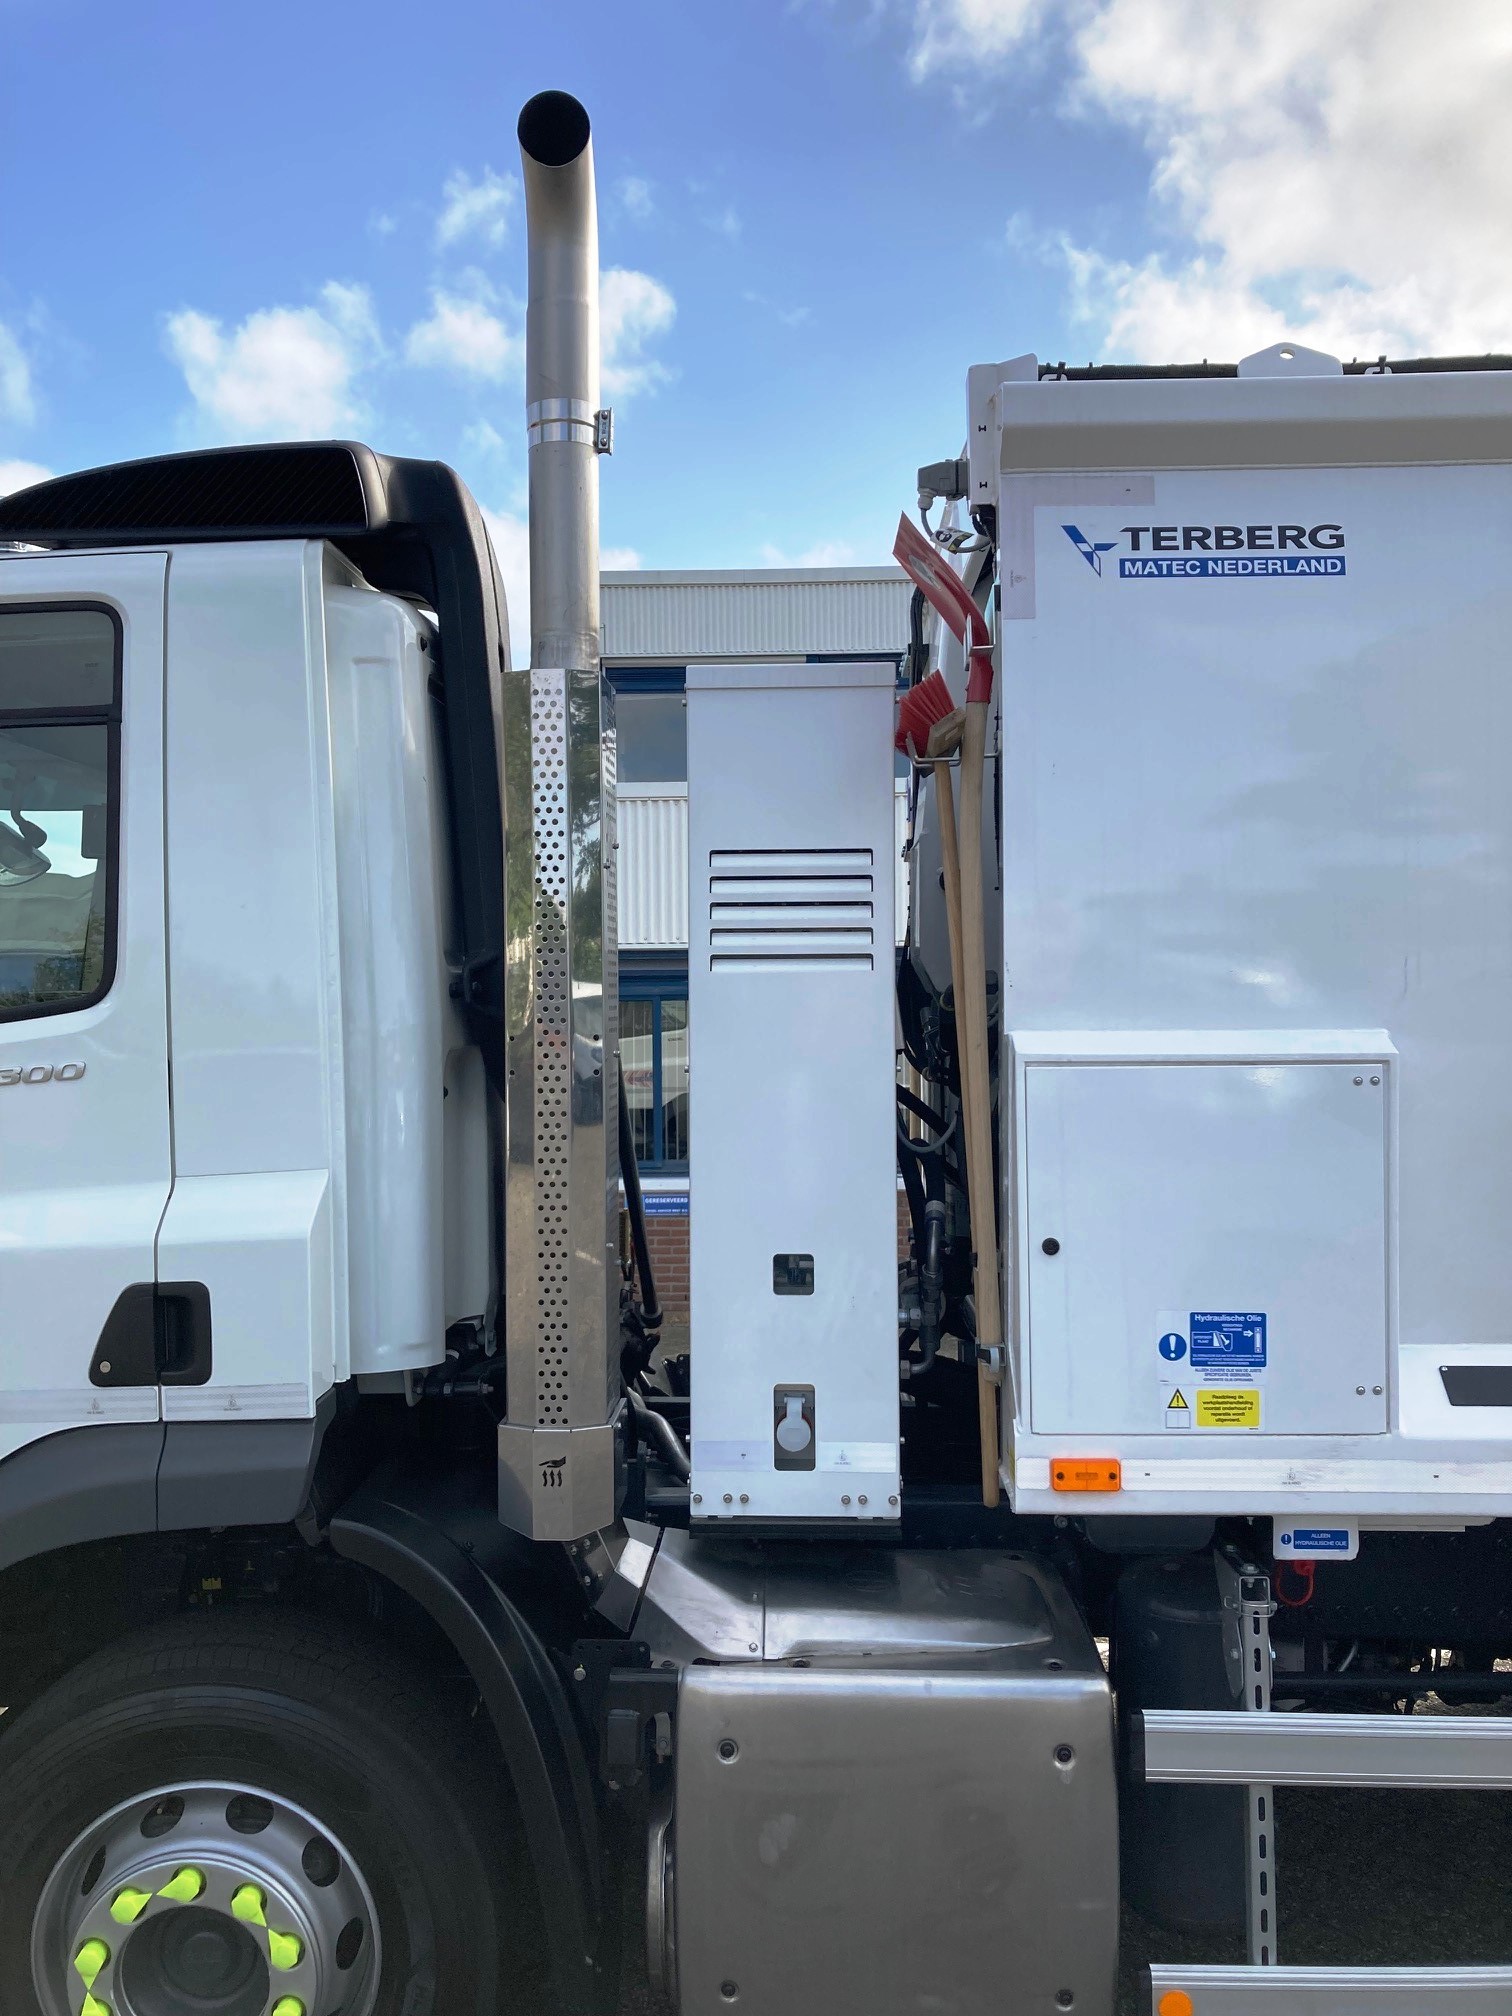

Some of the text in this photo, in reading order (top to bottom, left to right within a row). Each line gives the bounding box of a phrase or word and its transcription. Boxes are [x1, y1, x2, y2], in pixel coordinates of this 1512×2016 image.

[1119, 524, 1345, 551] TERBERG
[1124, 558, 1342, 575] MATEC NEDERLAND
[1194, 1314, 1262, 1322] Hydraulische Olie
